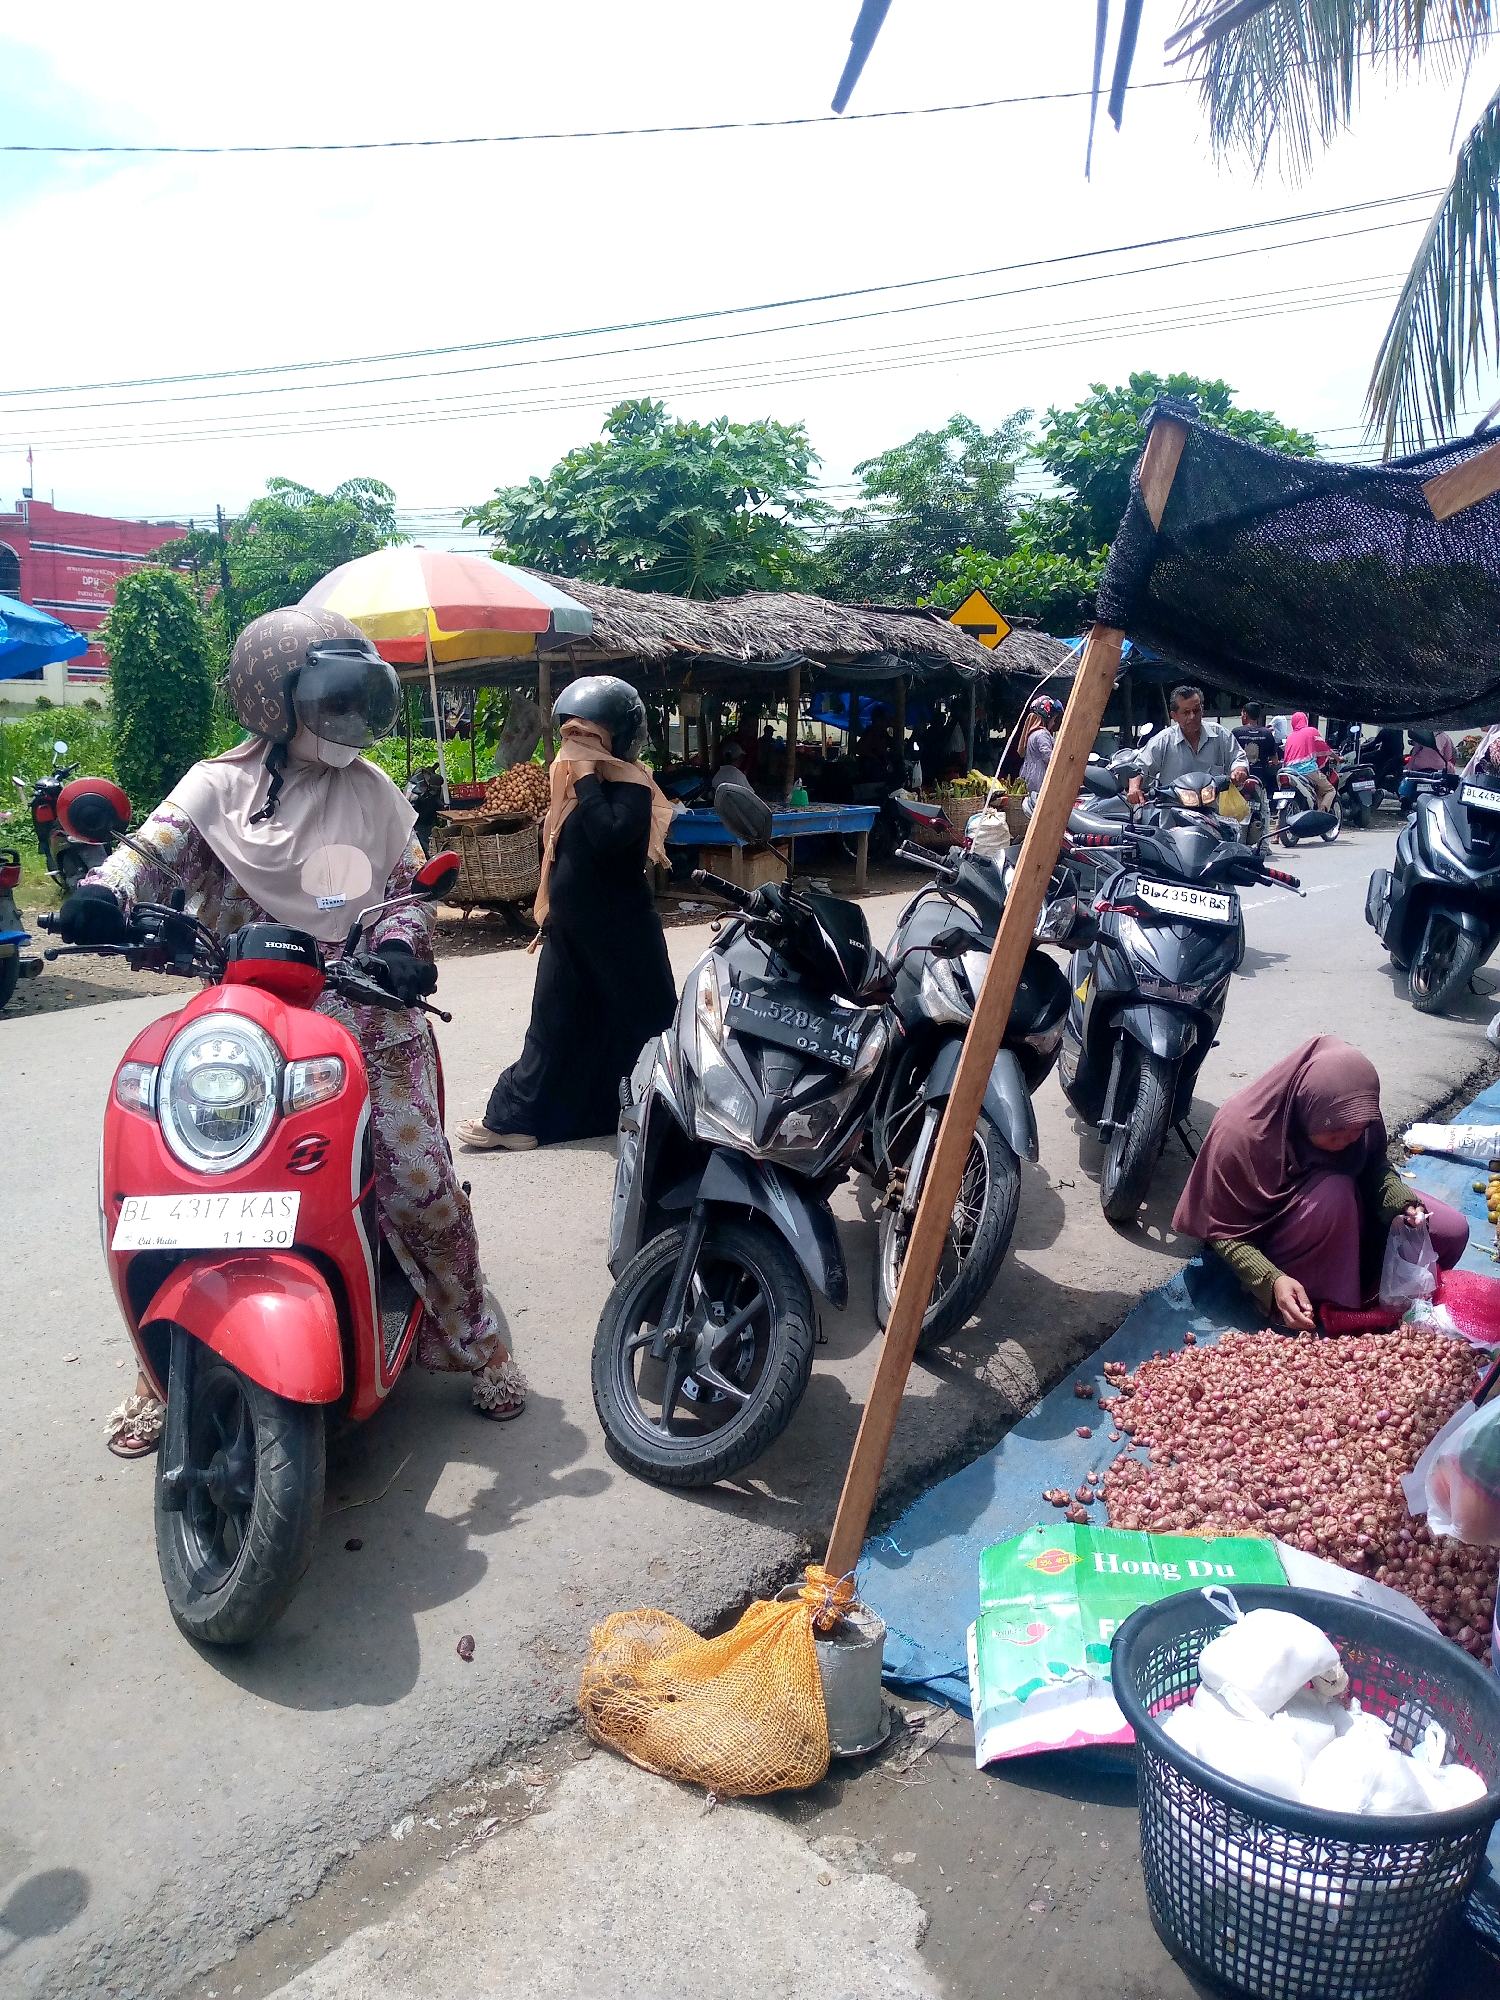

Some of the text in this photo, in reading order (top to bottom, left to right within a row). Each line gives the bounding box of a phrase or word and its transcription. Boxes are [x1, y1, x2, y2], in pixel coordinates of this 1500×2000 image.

[264, 941, 306, 953] HONDA
[729, 988, 755, 1013] BL
[768, 1001, 825, 1034] 5284
[123, 1196, 293, 1222] BL 4317 KAS
[1091, 1552, 1182, 1581] Hong
[1185, 1559, 1237, 1578] Du
